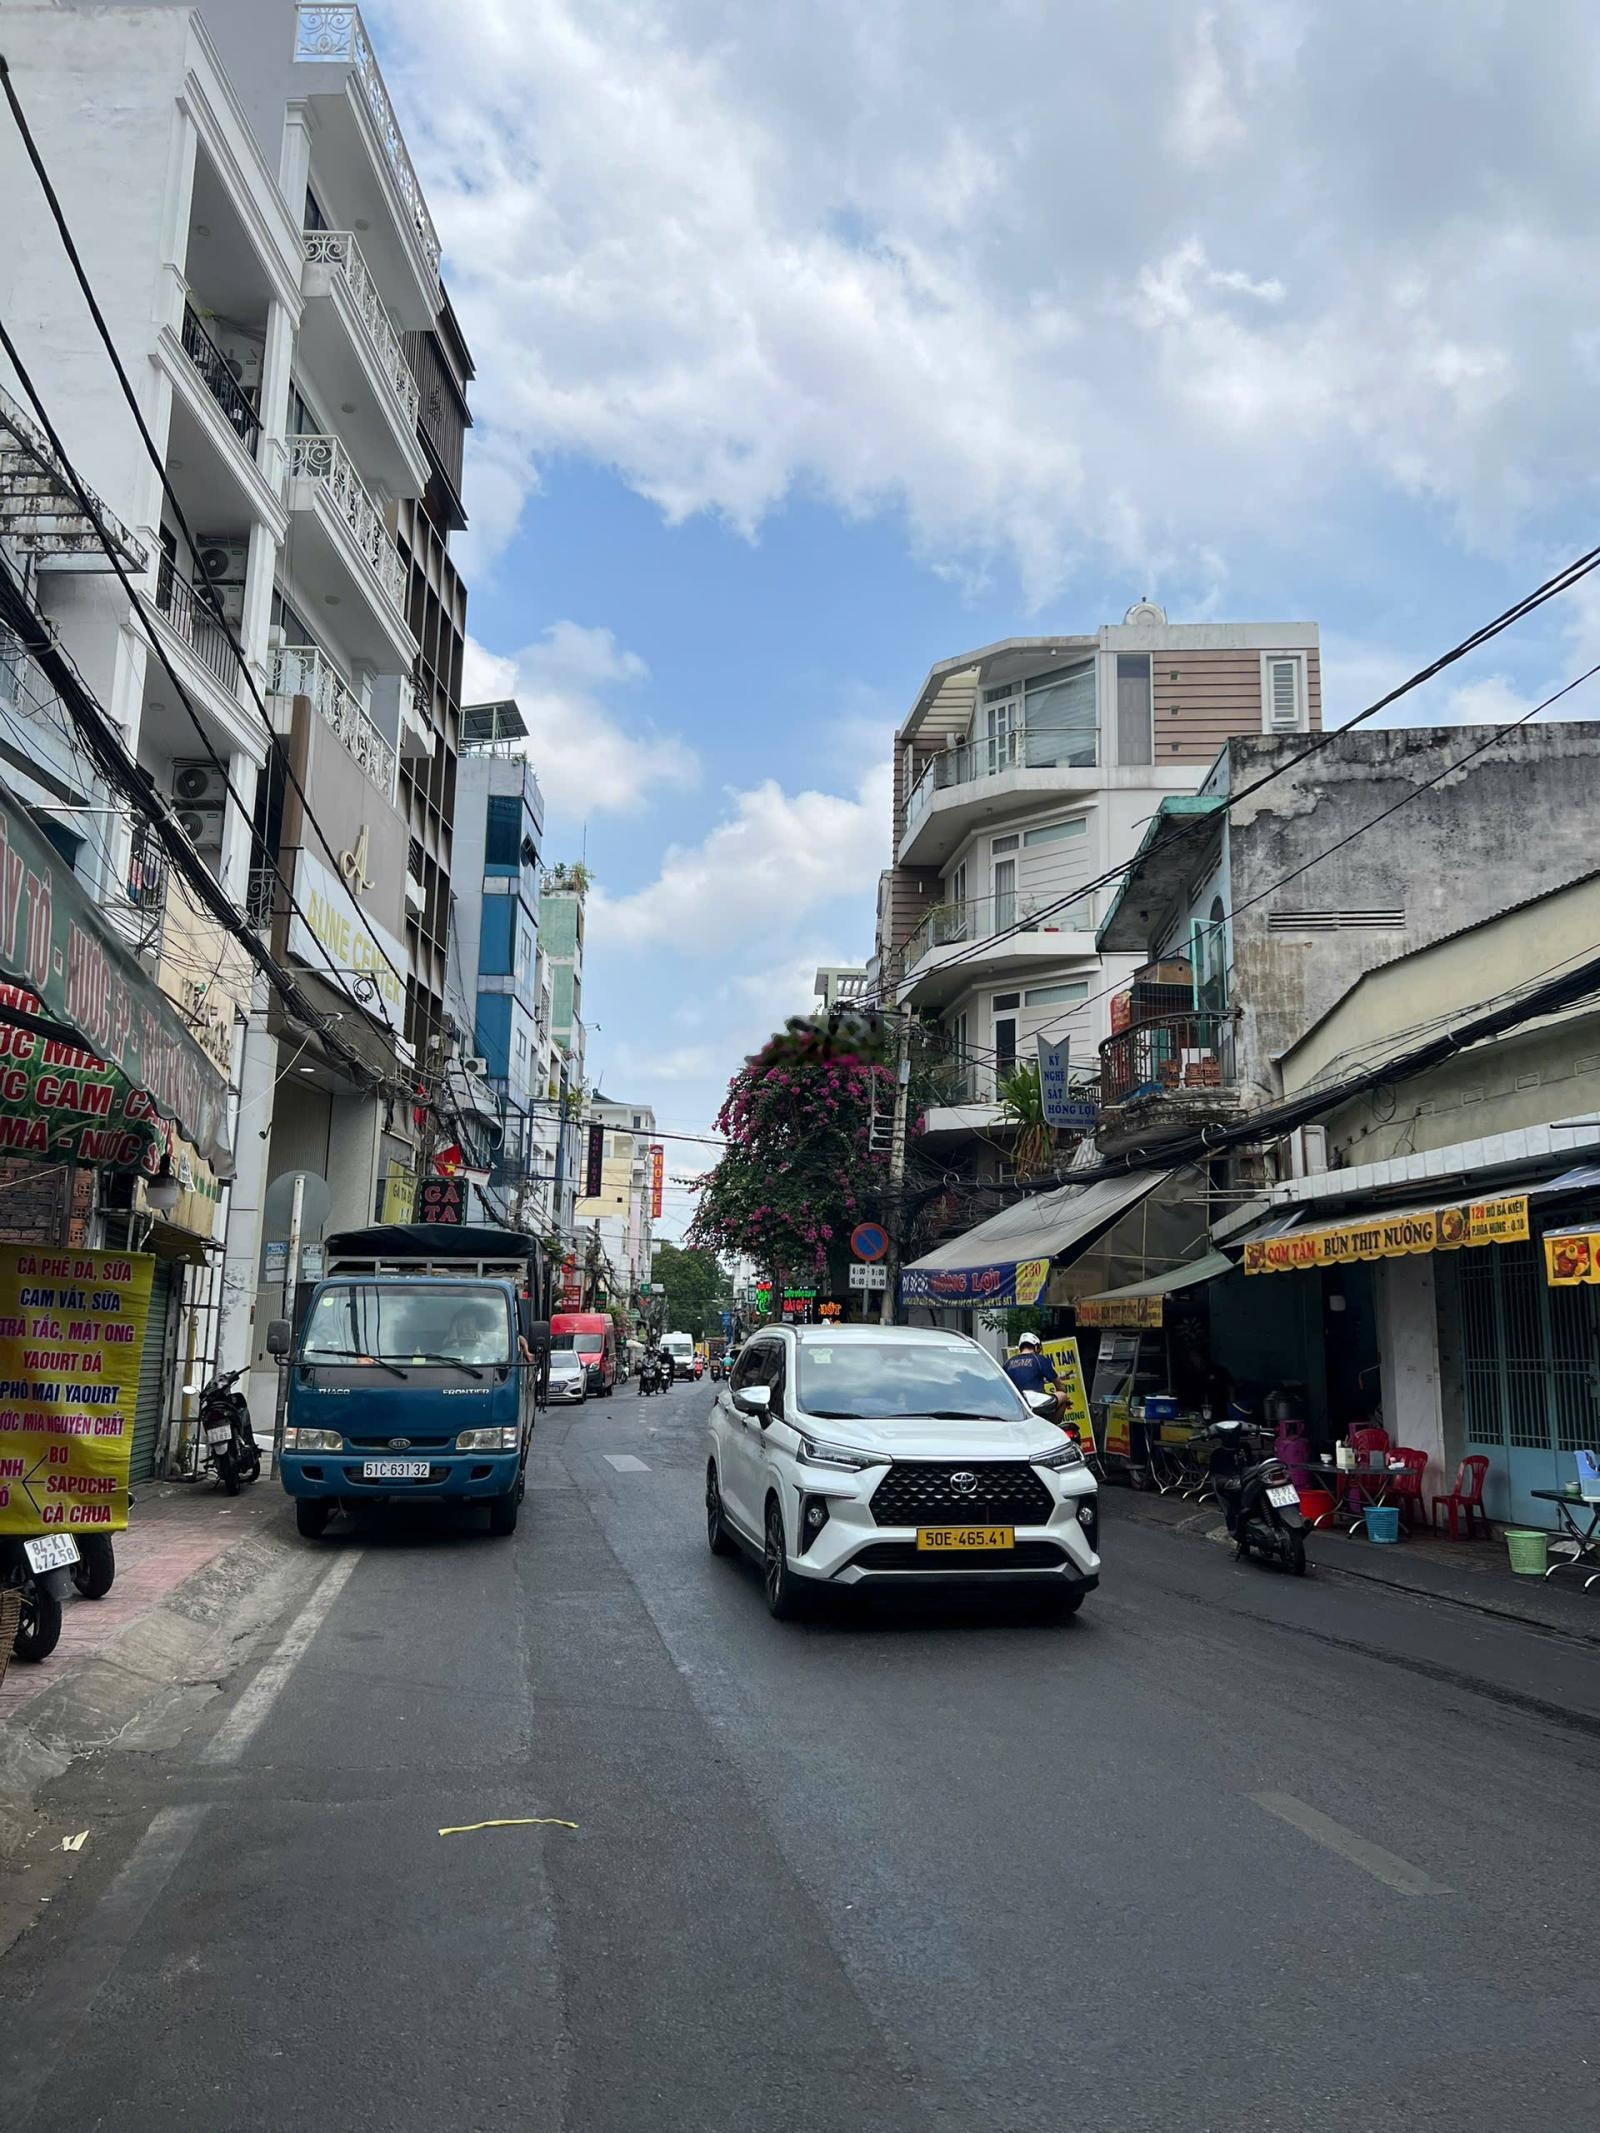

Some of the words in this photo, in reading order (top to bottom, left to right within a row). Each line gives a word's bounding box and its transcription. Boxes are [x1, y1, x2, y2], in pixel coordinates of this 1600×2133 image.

[305, 888, 350, 963] ALINE
[36, 1075, 115, 1117] CAM
[424, 1181, 460, 1204] GÀ
[651, 1153, 664, 1216] HOTEL
[423, 1205, 459, 1223] TA
[1293, 1234, 1316, 1261] TẤM
[1323, 1231, 1349, 1256] BÚN
[1351, 1229, 1381, 1255] THỊT
[1384, 1218, 1433, 1248] NƯỚNG
[16, 1253, 38, 1276] CÀ
[41, 1256, 71, 1278] PHÊ
[102, 1260, 132, 1282] SỮA
[20, 1287, 56, 1308] CAM
[91, 1290, 121, 1312] SỮA
[104, 1323, 135, 1343] ONG
[23, 1350, 80, 1372] YAOURT
[81, 1350, 104, 1373] ĐÁ
[32, 1384, 60, 1402] MAI
[65, 1385, 120, 1405] YAOURT
[46, 1414, 92, 1435] NGUYÊN
[94, 1411, 125, 1436] CHẤT
[48, 1446, 70, 1465] BƠ
[390, 1440, 409, 1448] KIA
[365, 1463, 428, 1477] 51C-631.32
[46, 1475, 117, 1495] SAPOCHE
[42, 1502, 65, 1525] CÀ
[69, 1504, 112, 1525] CHUA
[31, 1534, 67, 1556] 84-K1
[925, 1531, 1006, 1547] 50E-465.41
[34, 1548, 76, 1571] 472.58
